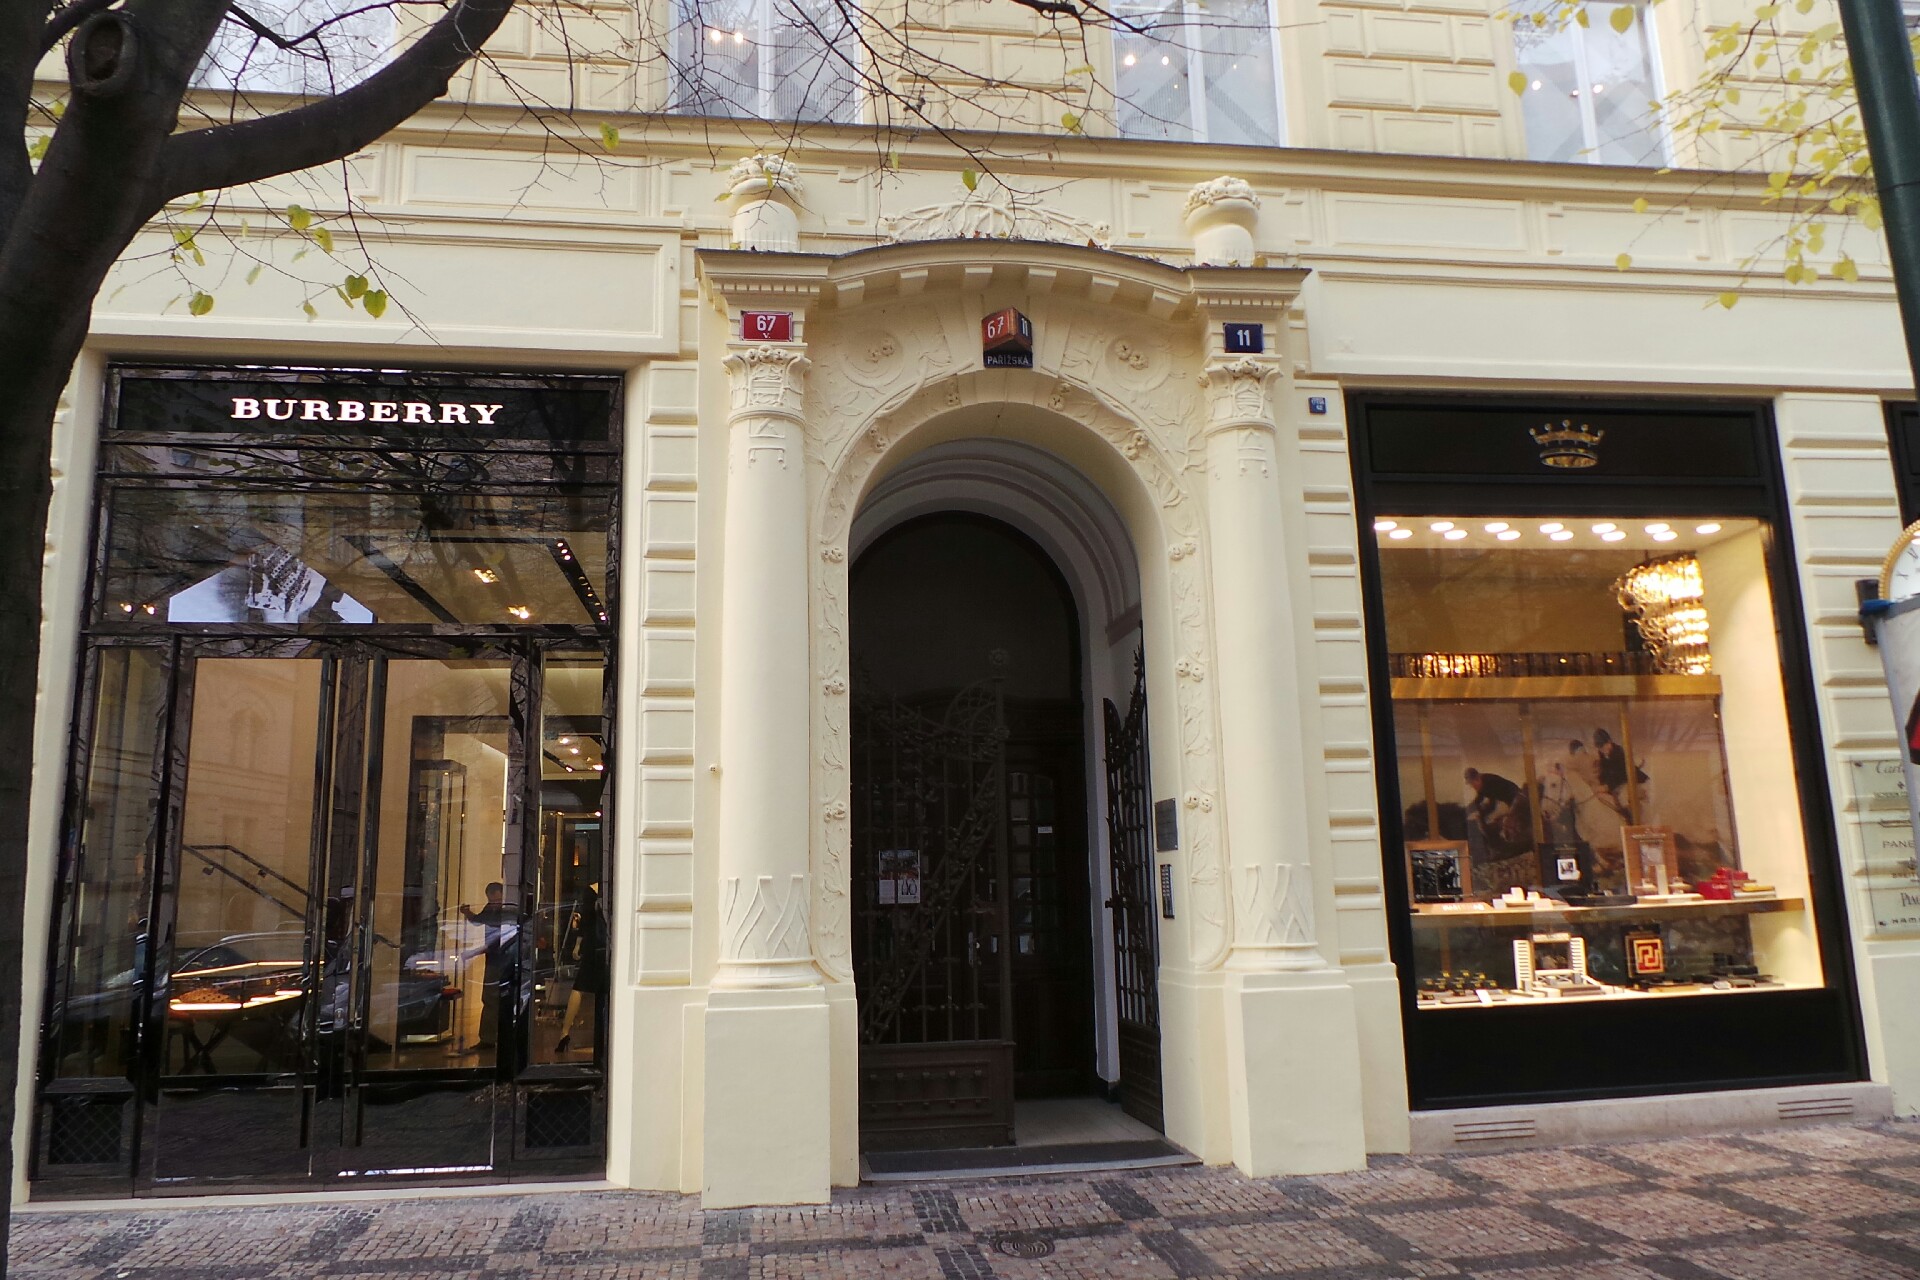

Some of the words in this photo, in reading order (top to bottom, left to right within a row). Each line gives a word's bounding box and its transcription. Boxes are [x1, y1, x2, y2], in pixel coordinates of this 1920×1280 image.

[756, 315, 776, 331] 67
[987, 316, 1004, 339] 67
[1021, 318, 1029, 337] 11
[1236, 329, 1250, 346] 11
[231, 398, 503, 425] BURBERRY
